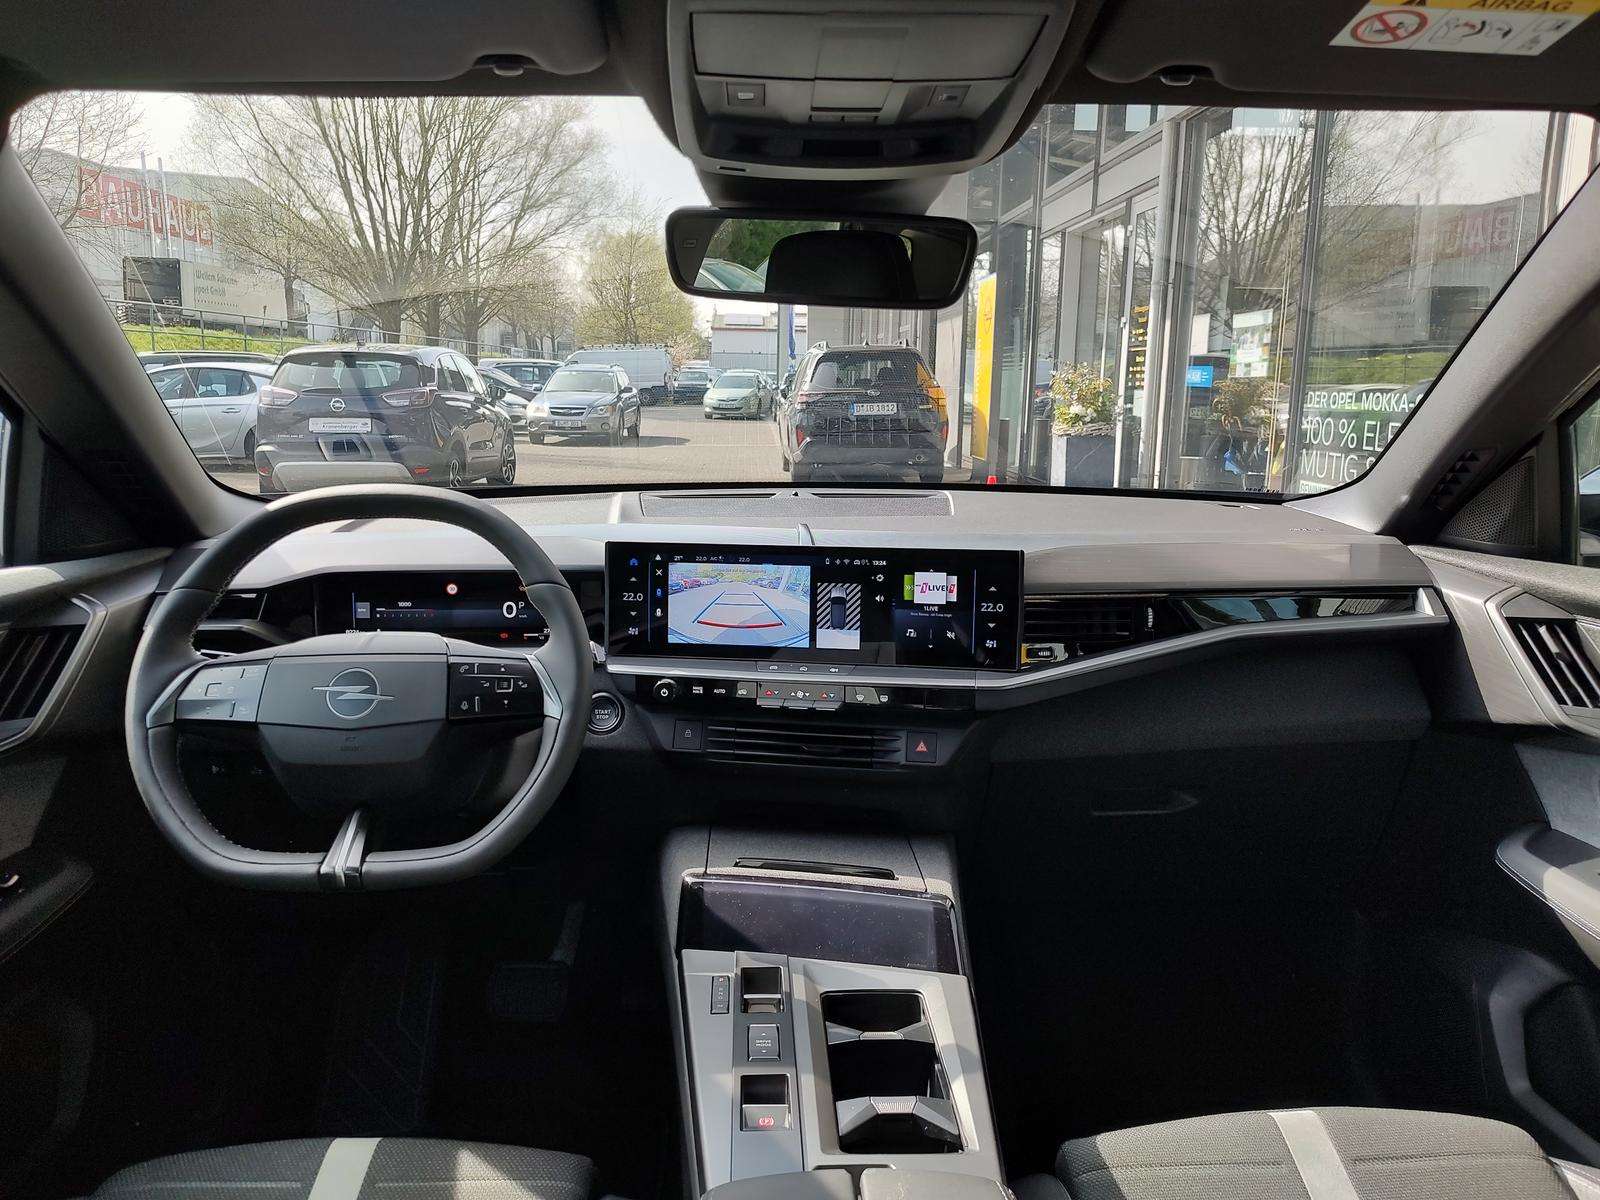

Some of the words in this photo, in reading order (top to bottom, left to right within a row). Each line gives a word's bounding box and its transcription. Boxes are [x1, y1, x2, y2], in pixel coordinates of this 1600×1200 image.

[1467, 0, 1574, 12] AIRBAG
[80, 175, 212, 243] BAUHAUS
[1306, 391, 1328, 408] DER
[1330, 391, 1358, 410] OPEL
[1303, 416, 1334, 446] 100
[1300, 448, 1359, 482] MUTIG
[622, 592, 644, 602] 22.0
[502, 601, 517, 618] 0
[980, 602, 1004, 612] 22.0
